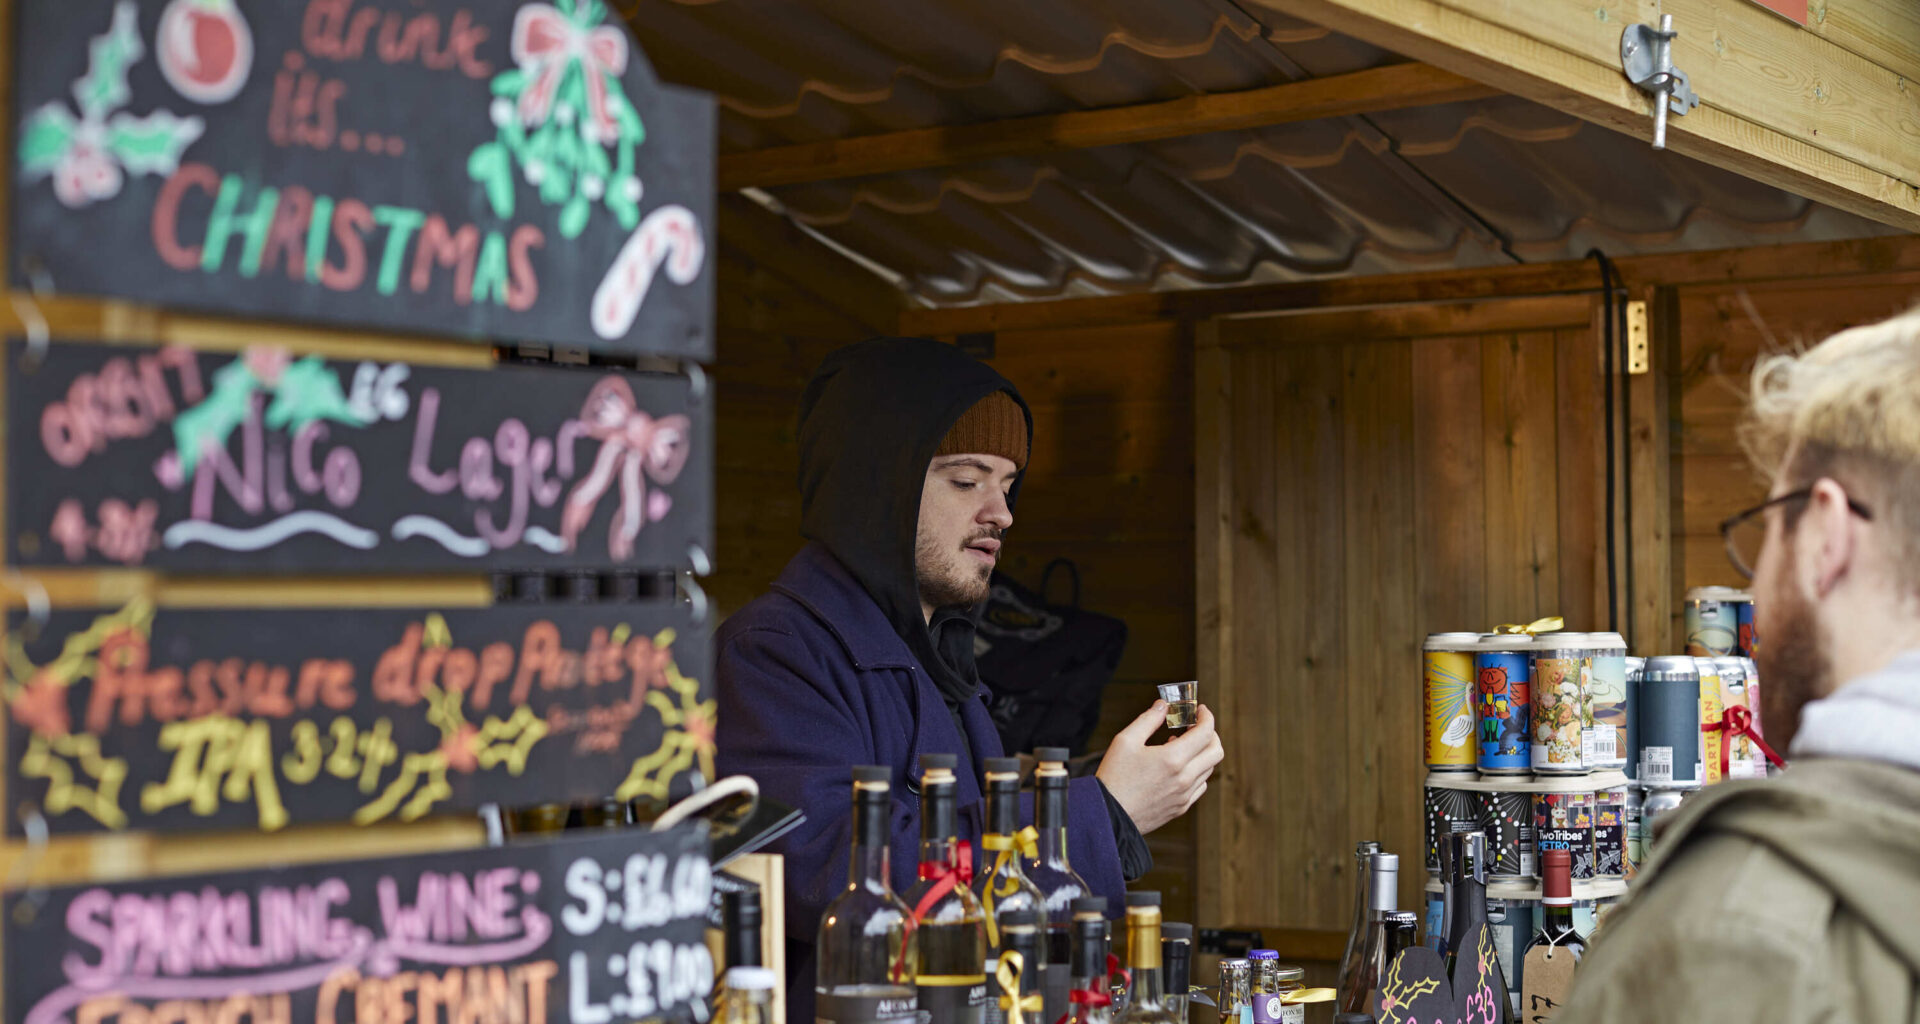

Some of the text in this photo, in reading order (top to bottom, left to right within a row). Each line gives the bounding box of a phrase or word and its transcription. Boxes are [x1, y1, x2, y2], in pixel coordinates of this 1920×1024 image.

[303, 0, 495, 78] drink
[151, 162, 545, 311] CHRISTMAS
[189, 386, 589, 549] Nico Lager
[86, 625, 358, 732] Pressure
[371, 622, 514, 710] drop
[1424, 677, 1432, 760] PARTIZAN
[140, 713, 289, 832] IPA
[1703, 700, 1719, 781] PARTIAN
[1538, 841, 1570, 850] METRO
